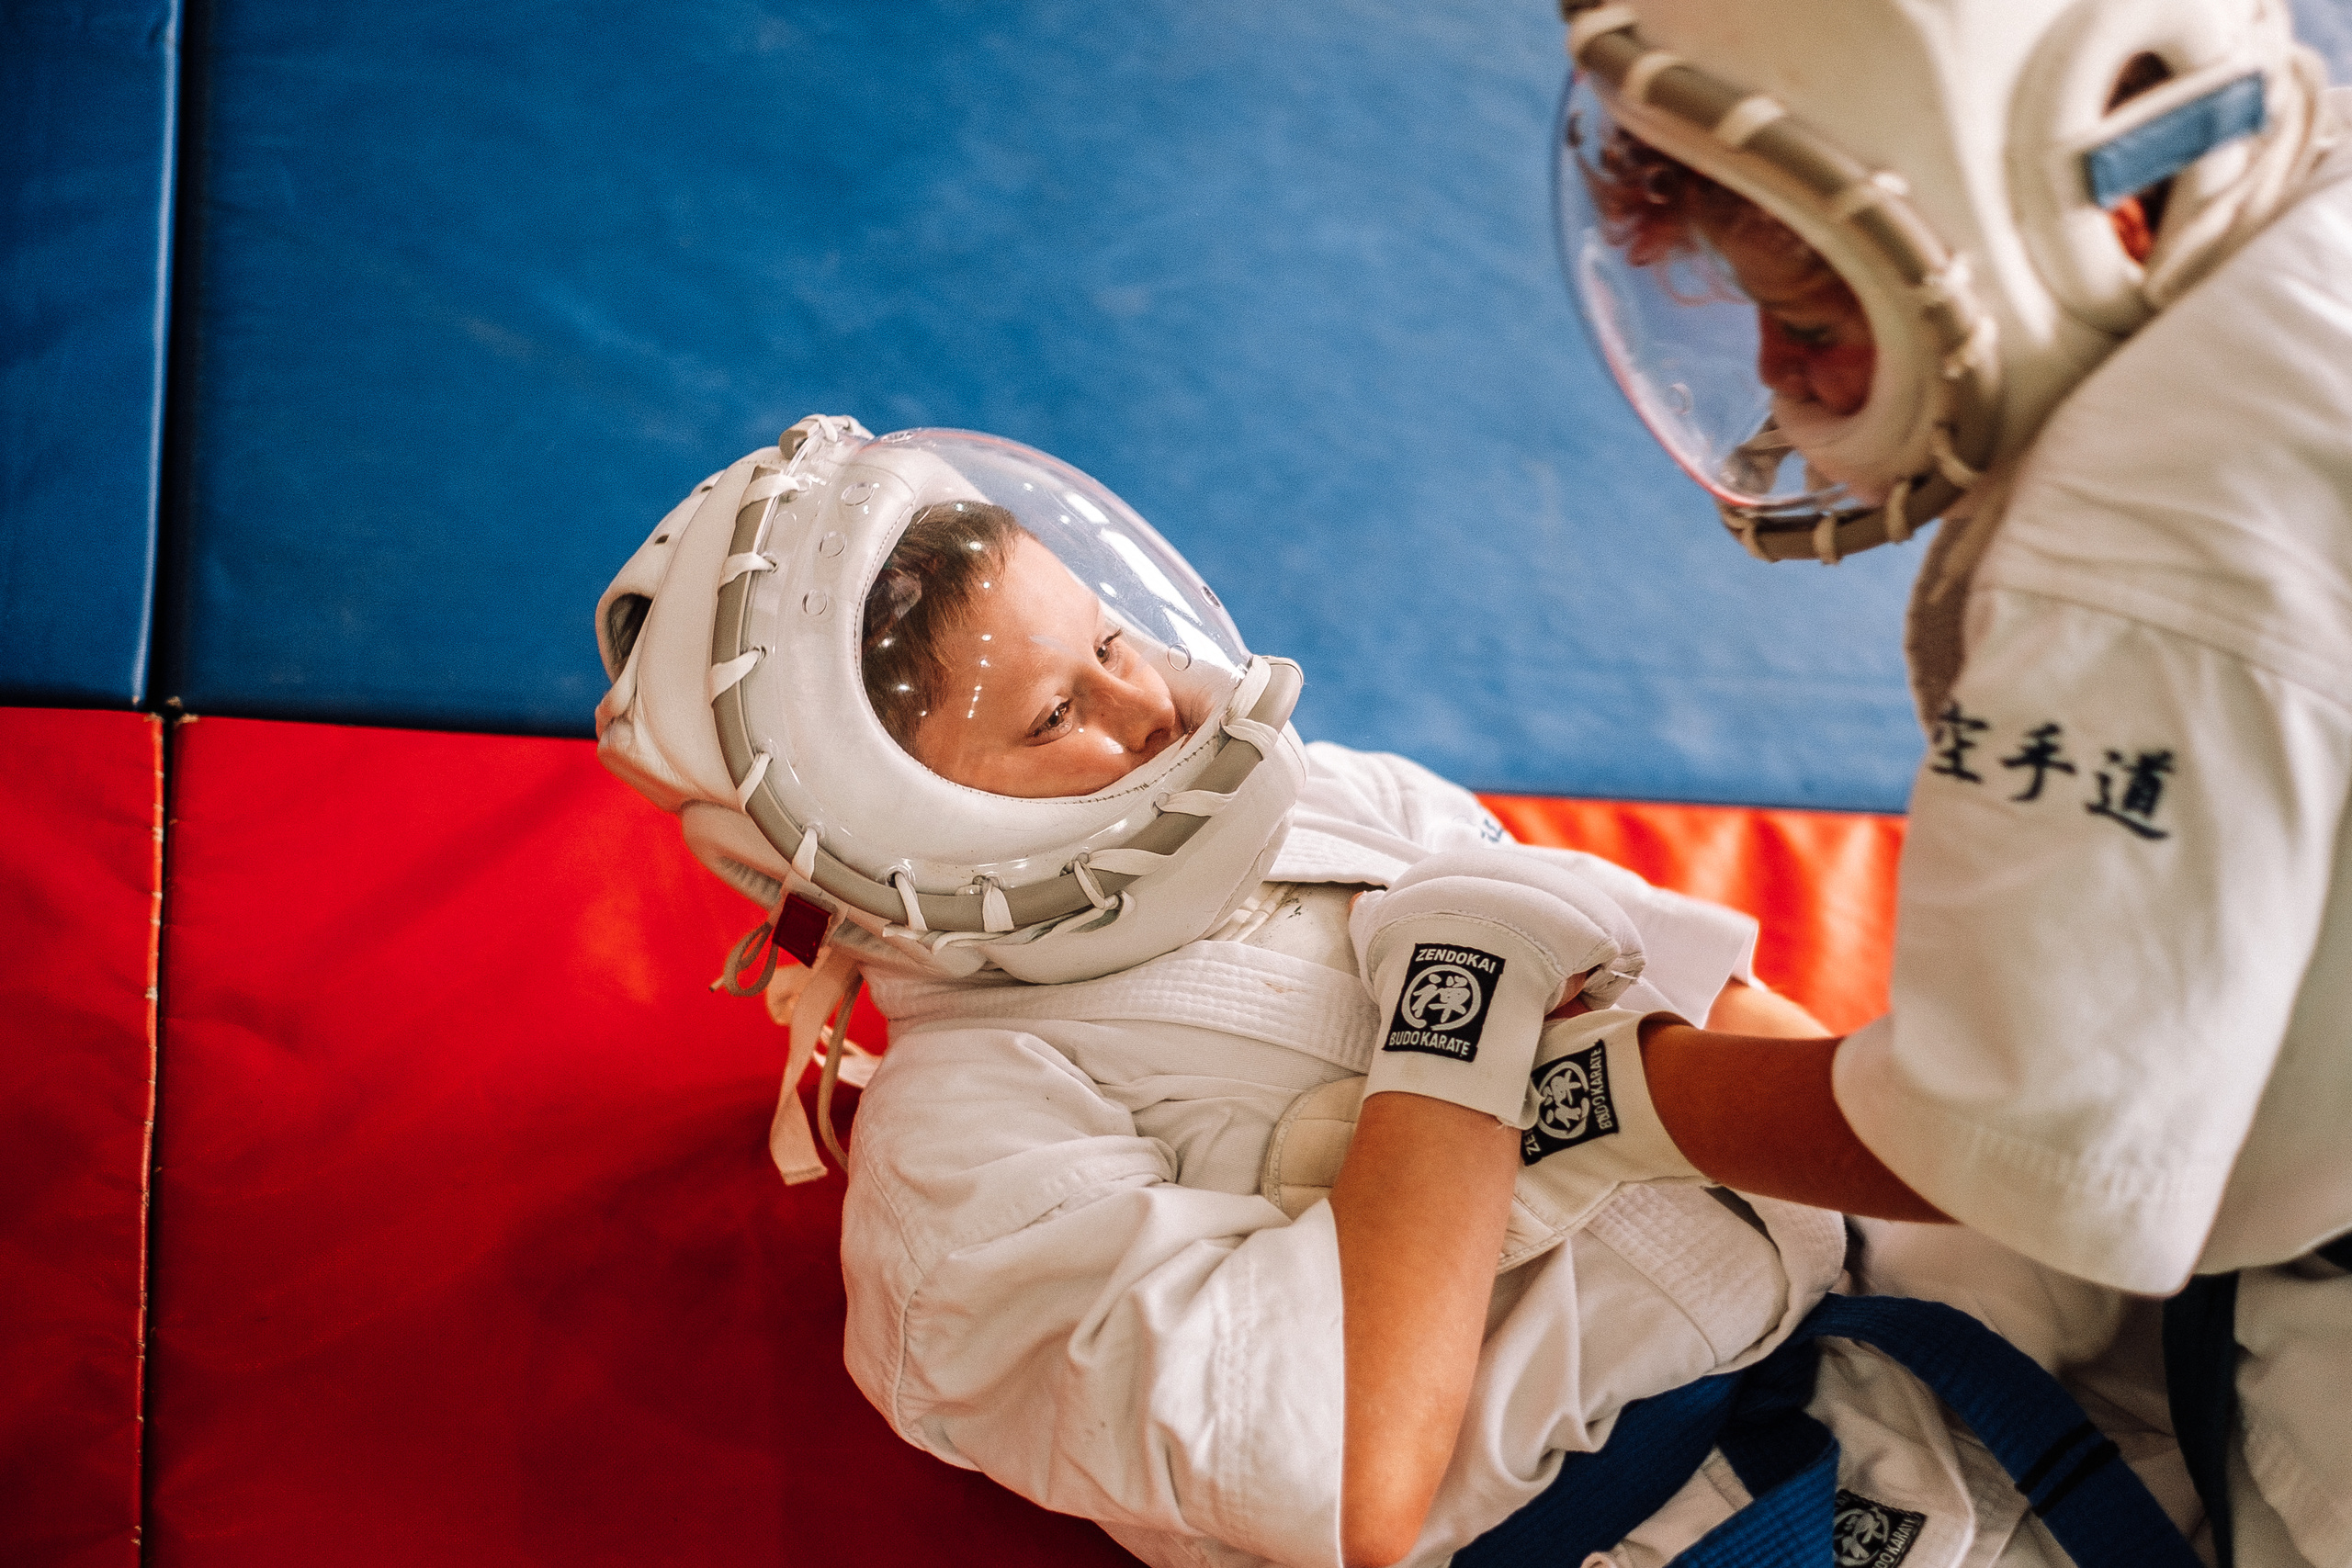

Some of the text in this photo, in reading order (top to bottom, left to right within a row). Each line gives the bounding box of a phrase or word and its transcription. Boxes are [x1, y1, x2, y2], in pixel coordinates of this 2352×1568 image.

[1931, 702, 2172, 840] 空手道
[1416, 949, 1496, 974] ZENDOKAI
[1389, 1031, 1471, 1055] BUDO KARATE
[1589, 1048, 1604, 1096] KARATE
